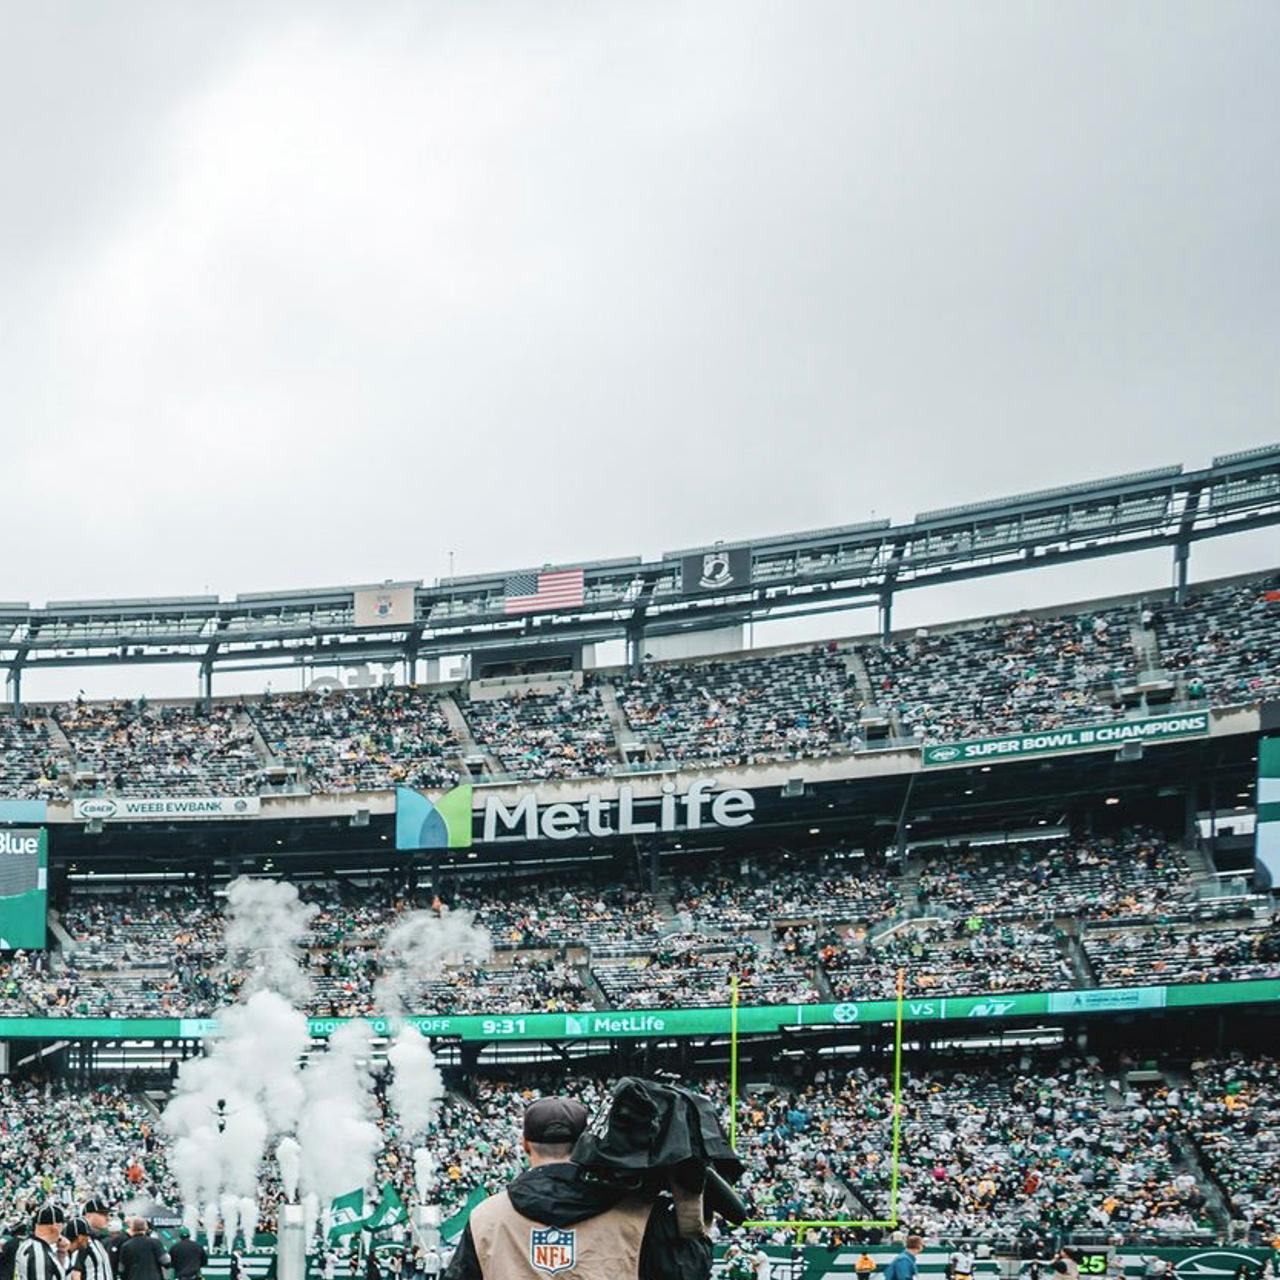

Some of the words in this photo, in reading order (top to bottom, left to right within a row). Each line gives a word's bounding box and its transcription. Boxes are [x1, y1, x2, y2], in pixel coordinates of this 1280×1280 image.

[964, 741, 1019, 758] SUPER
[1022, 733, 1078, 750] BOWL
[1080, 731, 1094, 743] III
[1096, 716, 1207, 741] CHAMPIONS
[126, 802, 165, 813] WEEB
[166, 801, 223, 813] EWBANK
[483, 779, 756, 843] MetLife
[968, 999, 1016, 1017] NY
[482, 1019, 526, 1035] 9:31
[594, 1016, 665, 1033] MetLife
[536, 1246, 570, 1268] NFL
